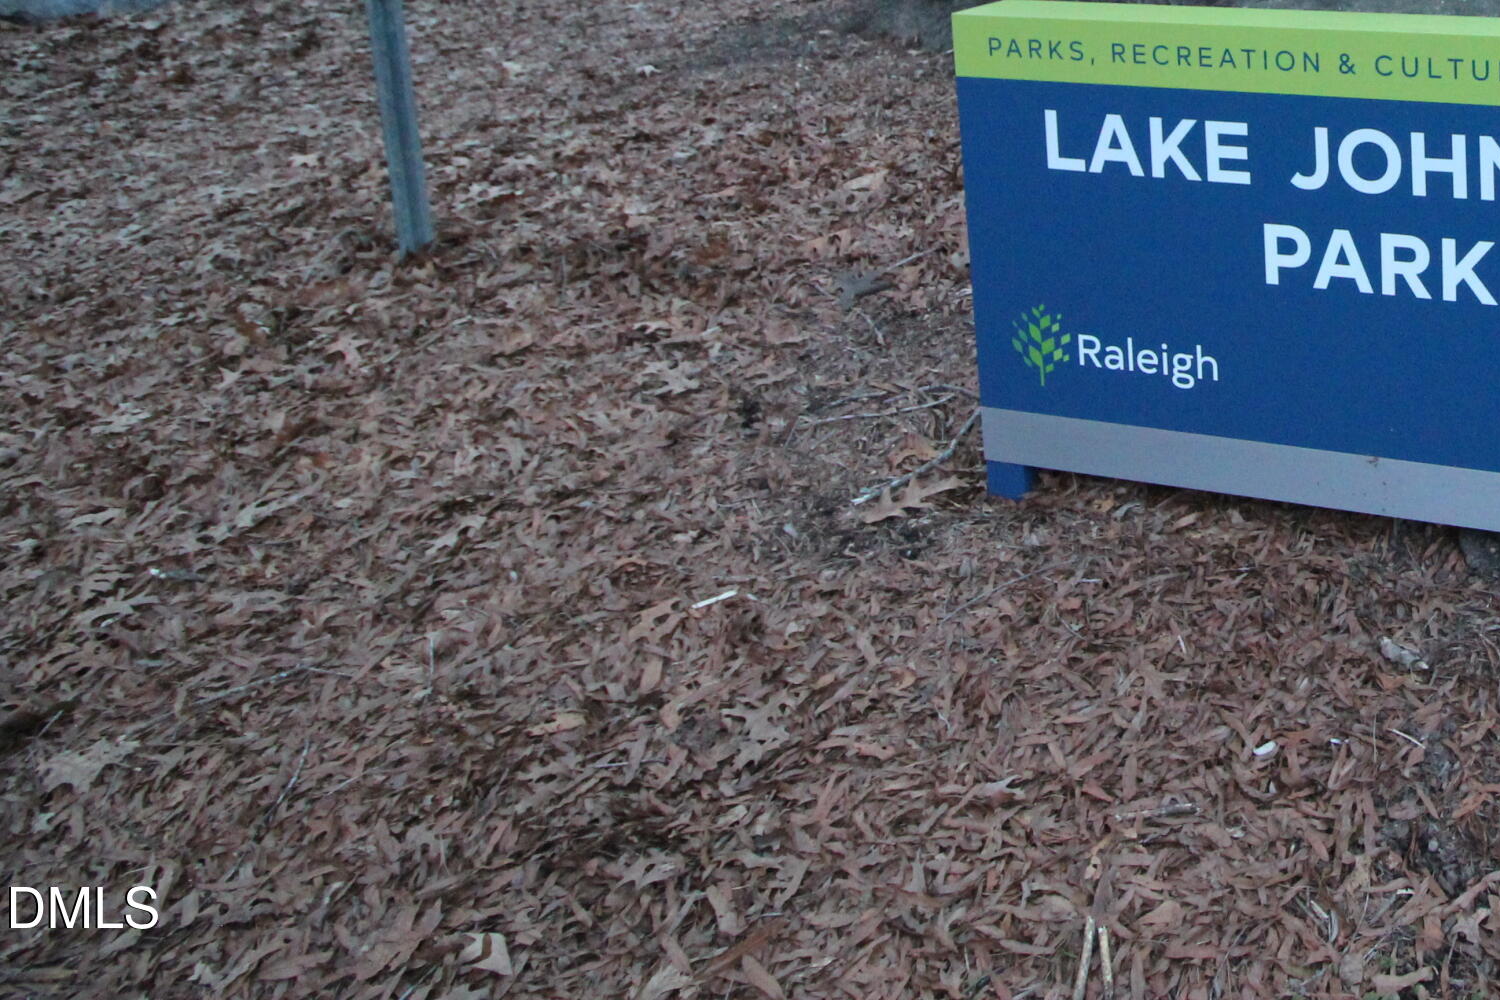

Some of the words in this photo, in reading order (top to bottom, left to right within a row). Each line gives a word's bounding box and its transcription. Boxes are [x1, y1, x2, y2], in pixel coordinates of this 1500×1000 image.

[989, 37, 1094, 65] PARKS,
[1112, 43, 1319, 72] RECREATION
[1339, 53, 1355, 74] &
[1045, 110, 1250, 184] LAKE
[1264, 224, 1498, 305] PARK
[1078, 334, 1218, 388] Raleigh
